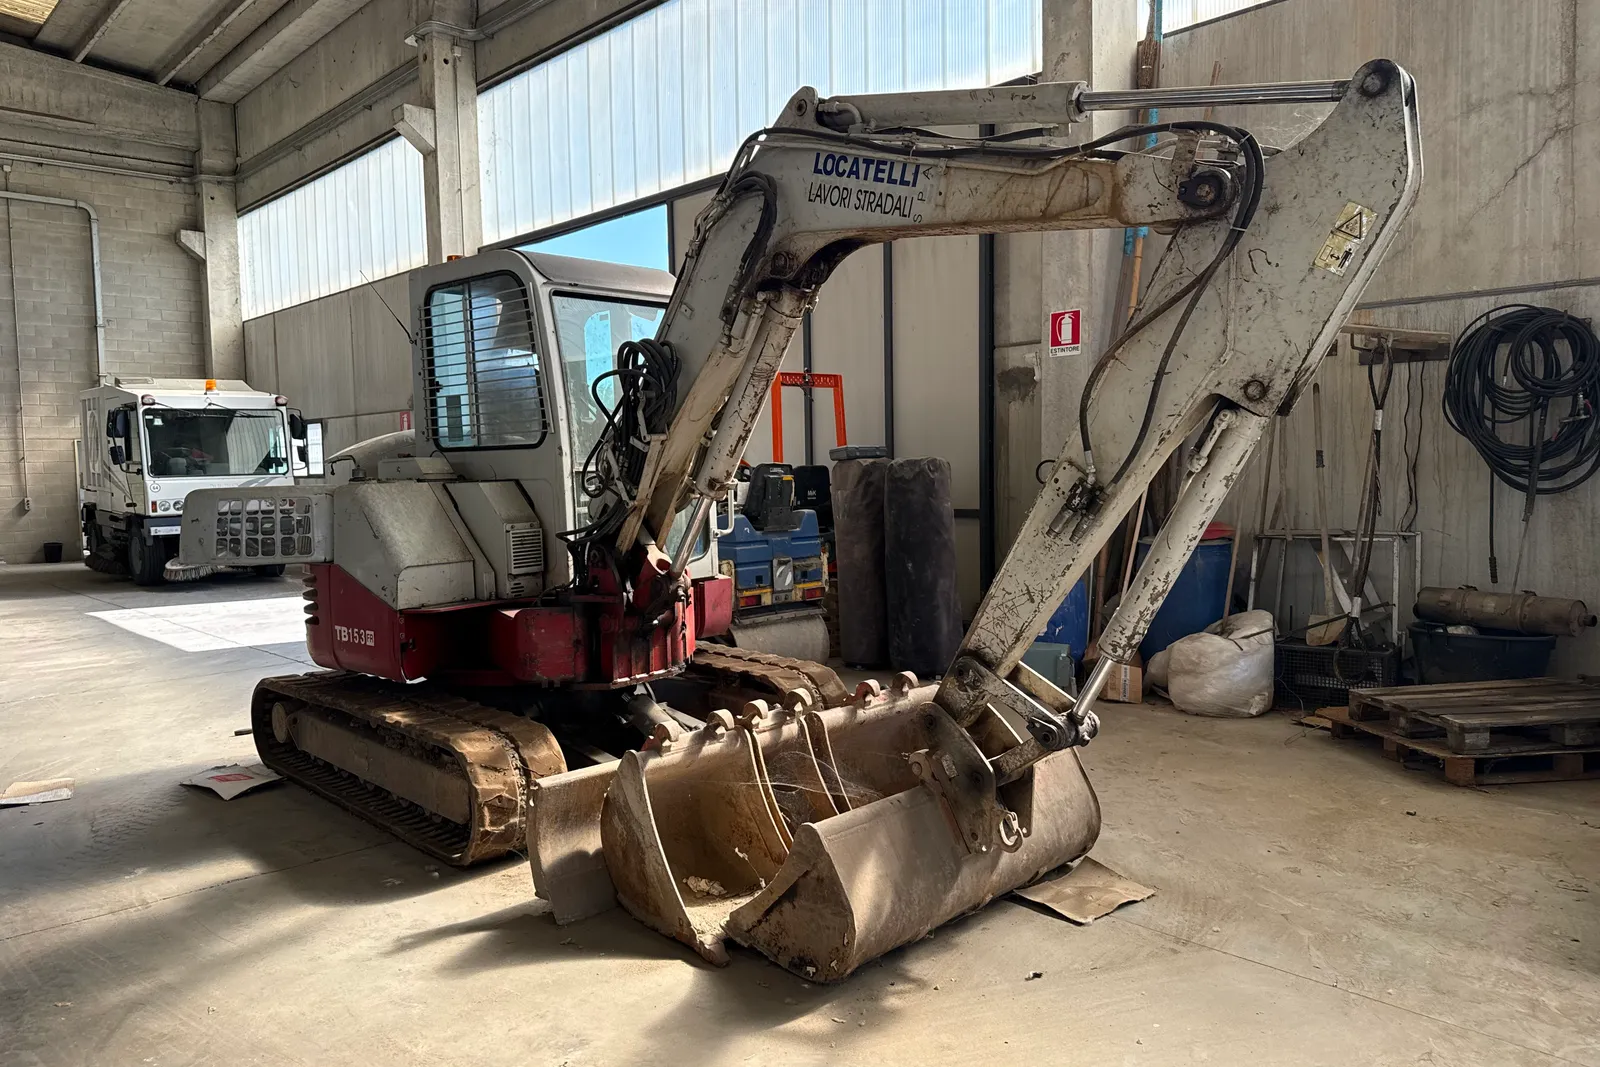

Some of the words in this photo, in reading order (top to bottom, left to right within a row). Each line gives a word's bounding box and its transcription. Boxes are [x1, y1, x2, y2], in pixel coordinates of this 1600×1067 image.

[813, 152, 921, 188] LOCATELLI
[807, 181, 853, 209] LAVORI
[854, 188, 914, 218] STRADALI
[1050, 345, 1080, 354] ESTINTORE
